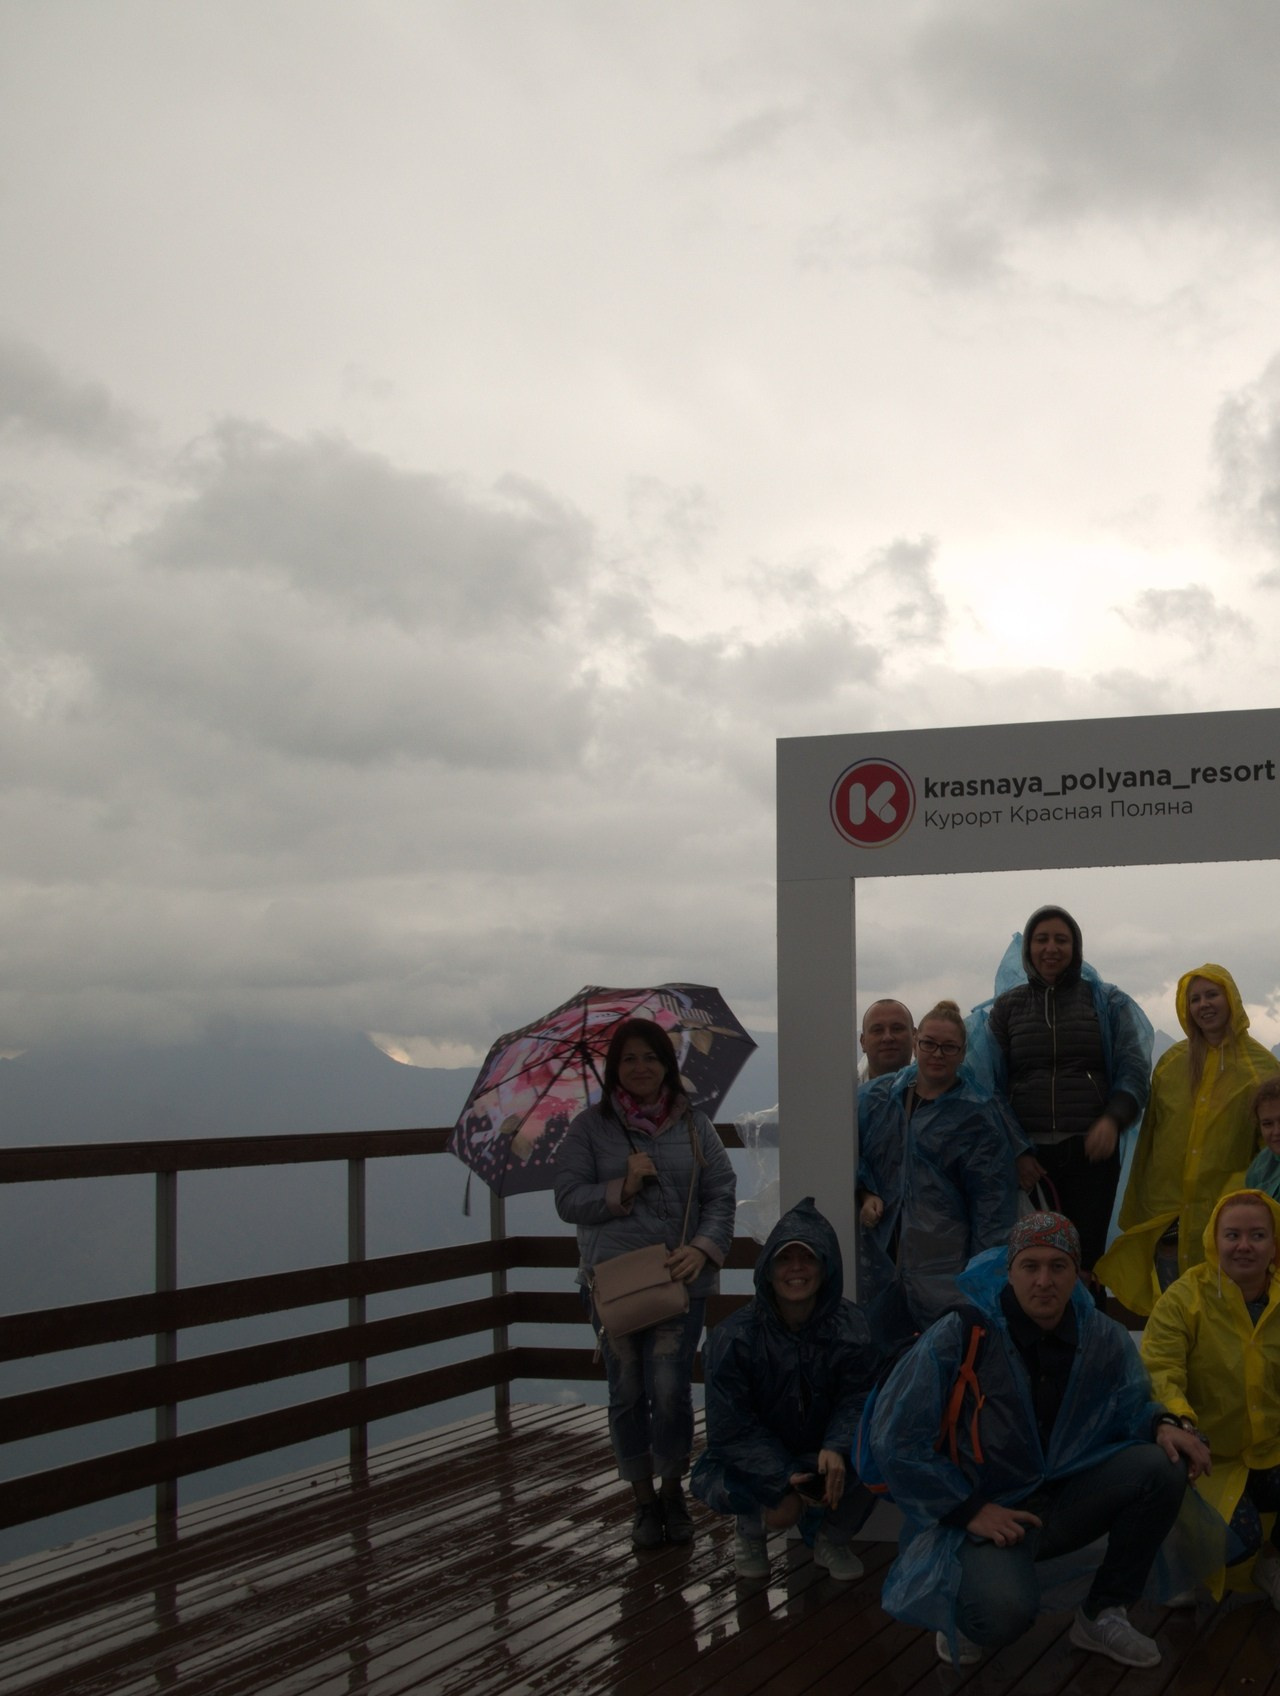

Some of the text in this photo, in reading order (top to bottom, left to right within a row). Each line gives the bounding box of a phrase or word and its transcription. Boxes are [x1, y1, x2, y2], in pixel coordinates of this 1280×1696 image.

[924, 759, 1276, 799] krasnaya_polyana_resort
[924, 800, 1193, 830] Курорт Красная Поляна
